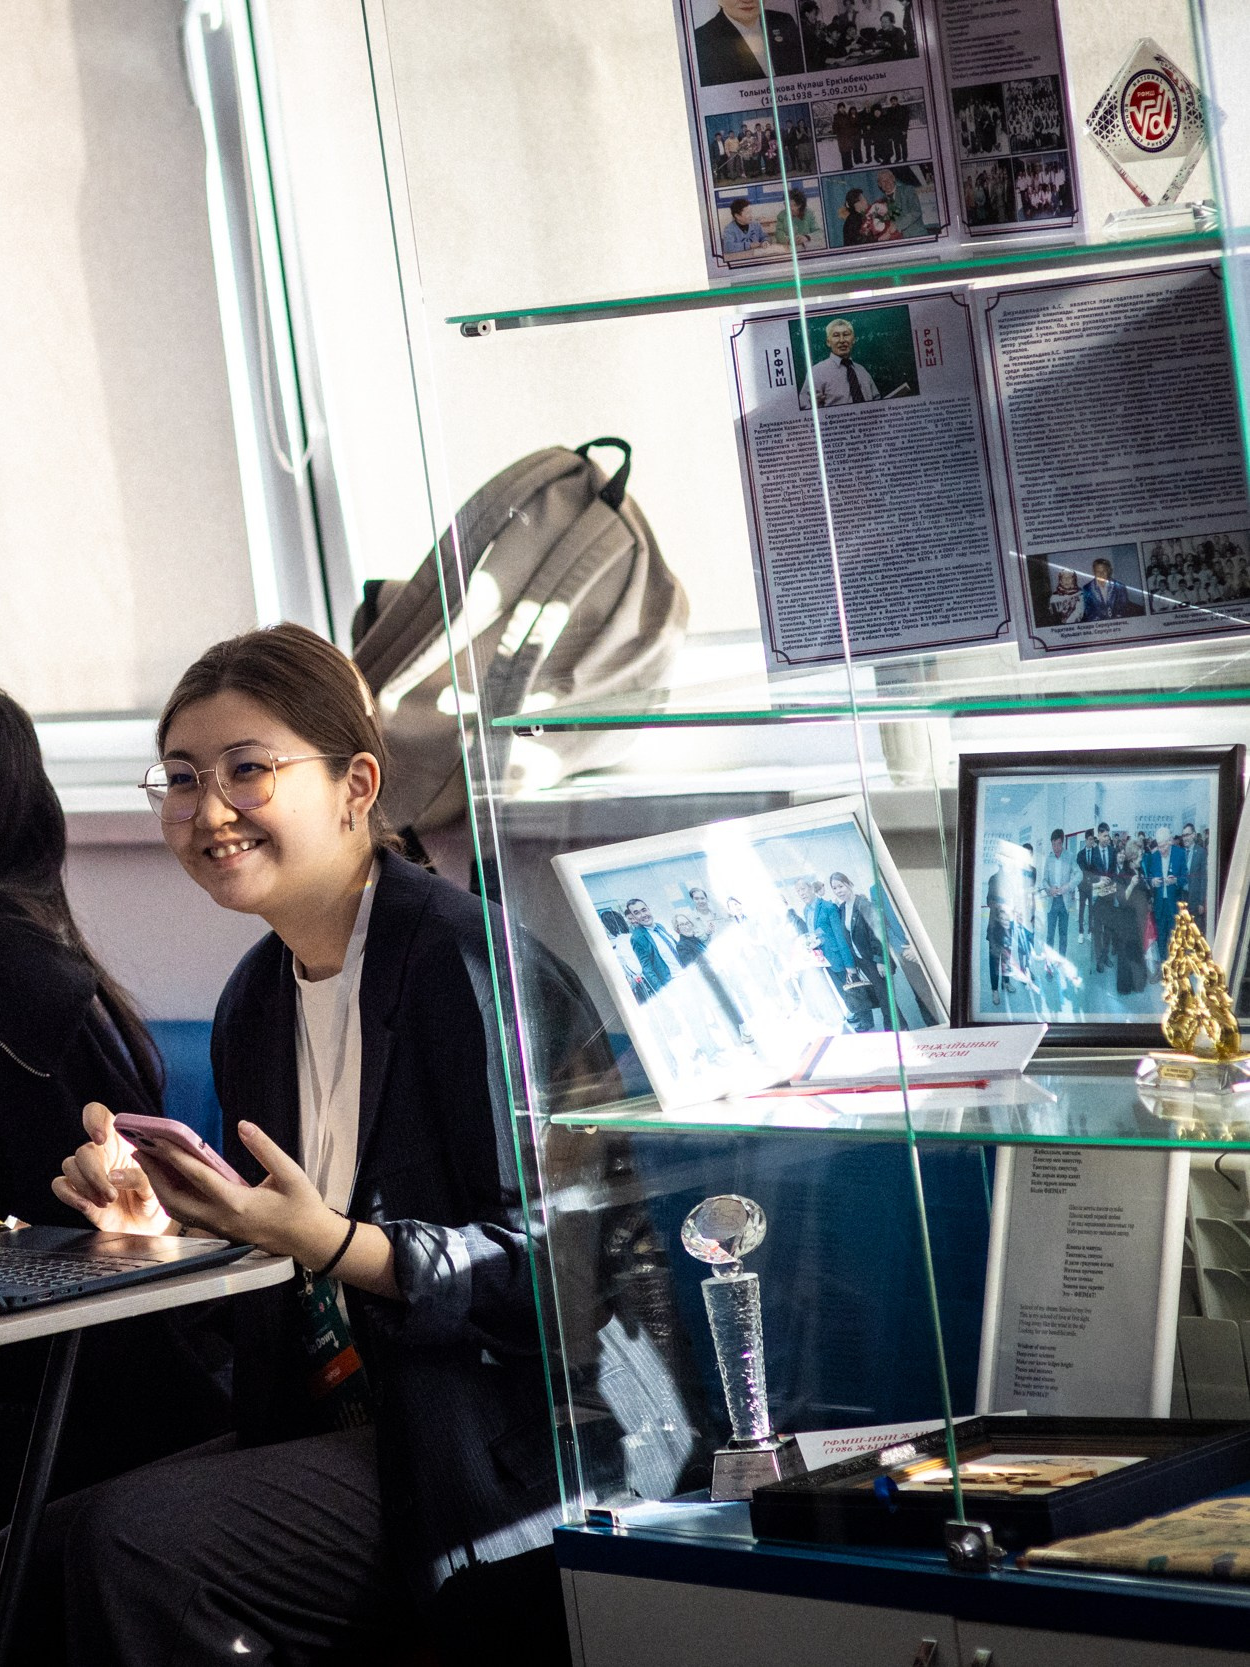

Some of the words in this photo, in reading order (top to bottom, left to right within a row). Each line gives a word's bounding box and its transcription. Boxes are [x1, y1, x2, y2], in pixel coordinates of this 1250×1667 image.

[739, 85, 795, 98] Толымбкова
[826, 72, 886, 87] Еркімбекқызы
[1133, 75, 1162, 87] NATIONAL
[761, 92, 812, 107] (1.04.1938
[822, 84, 868, 97] 5.09.2014)
[924, 328, 936, 366] РФМШ
[774, 348, 786, 387] РФМШ
[825, 1445, 853, 1454] (1986
